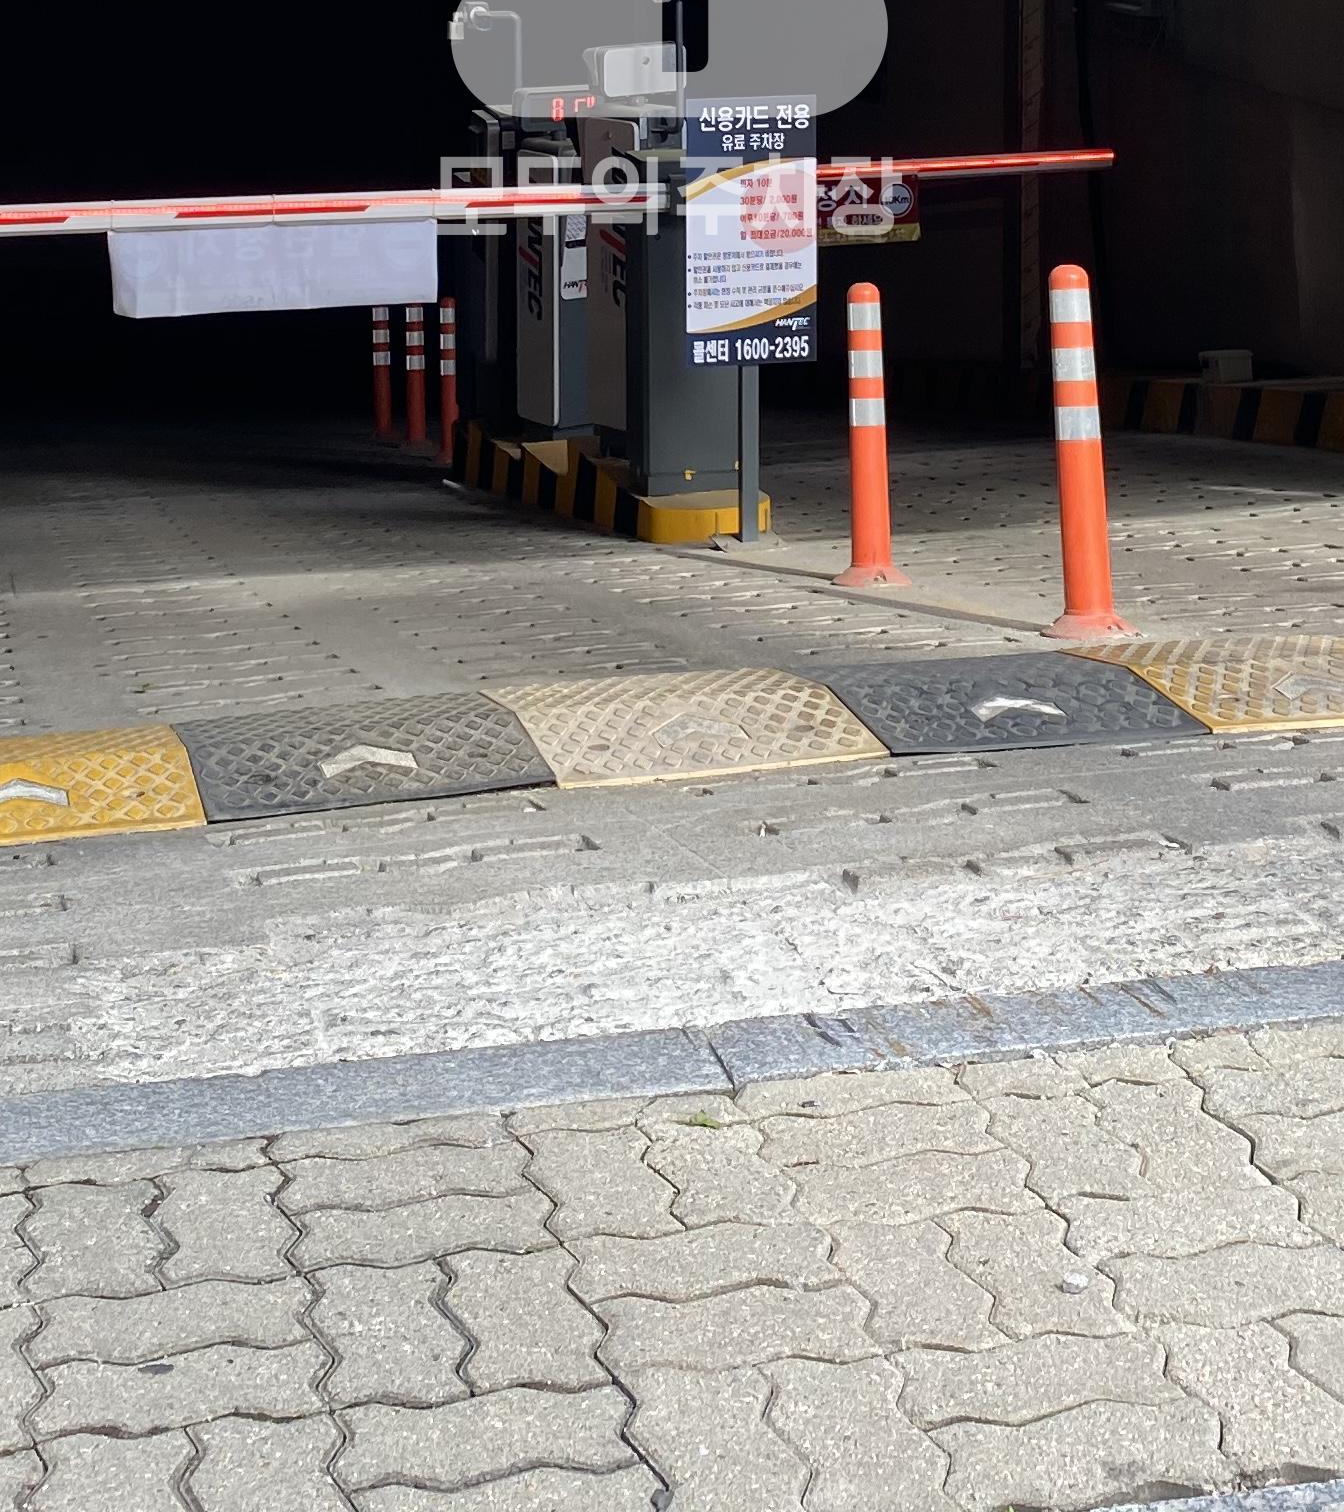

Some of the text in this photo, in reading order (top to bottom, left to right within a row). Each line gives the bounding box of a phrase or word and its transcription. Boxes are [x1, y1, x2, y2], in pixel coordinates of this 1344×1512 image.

[699, 104, 810, 132] 신용카드 전용
[722, 133, 785, 151] 유료 주차장
[775, 317, 810, 330] HANTEC
[693, 335, 809, 363] 콜센터 1600-2395
